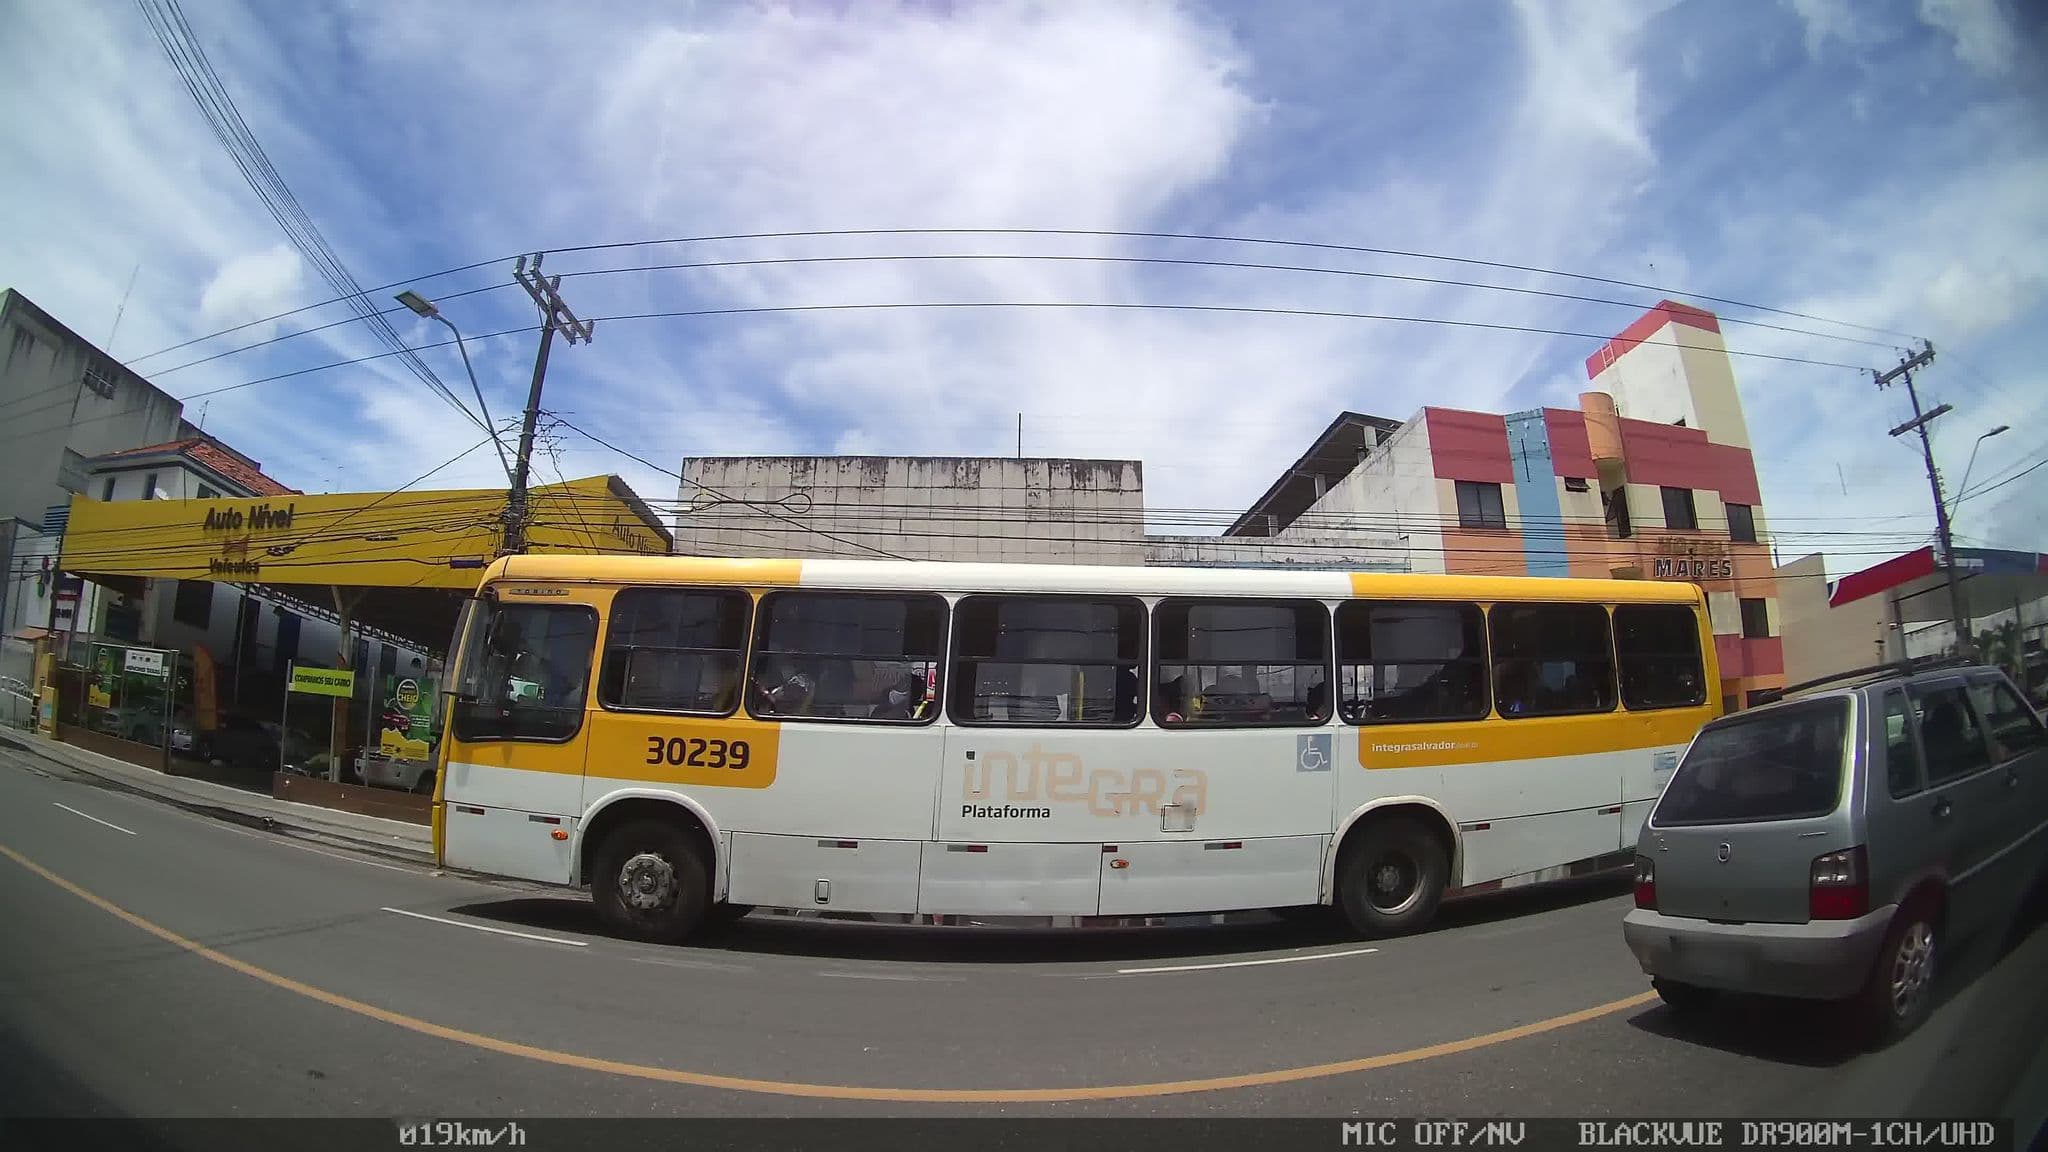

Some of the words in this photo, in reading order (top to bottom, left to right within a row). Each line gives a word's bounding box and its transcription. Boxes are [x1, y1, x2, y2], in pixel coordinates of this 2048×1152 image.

[203, 507, 243, 530] Auto
[248, 503, 294, 529] Nível
[1654, 557, 1733, 578] MARES
[646, 736, 750, 770] 30239
[961, 804, 1051, 819] Plataforma
